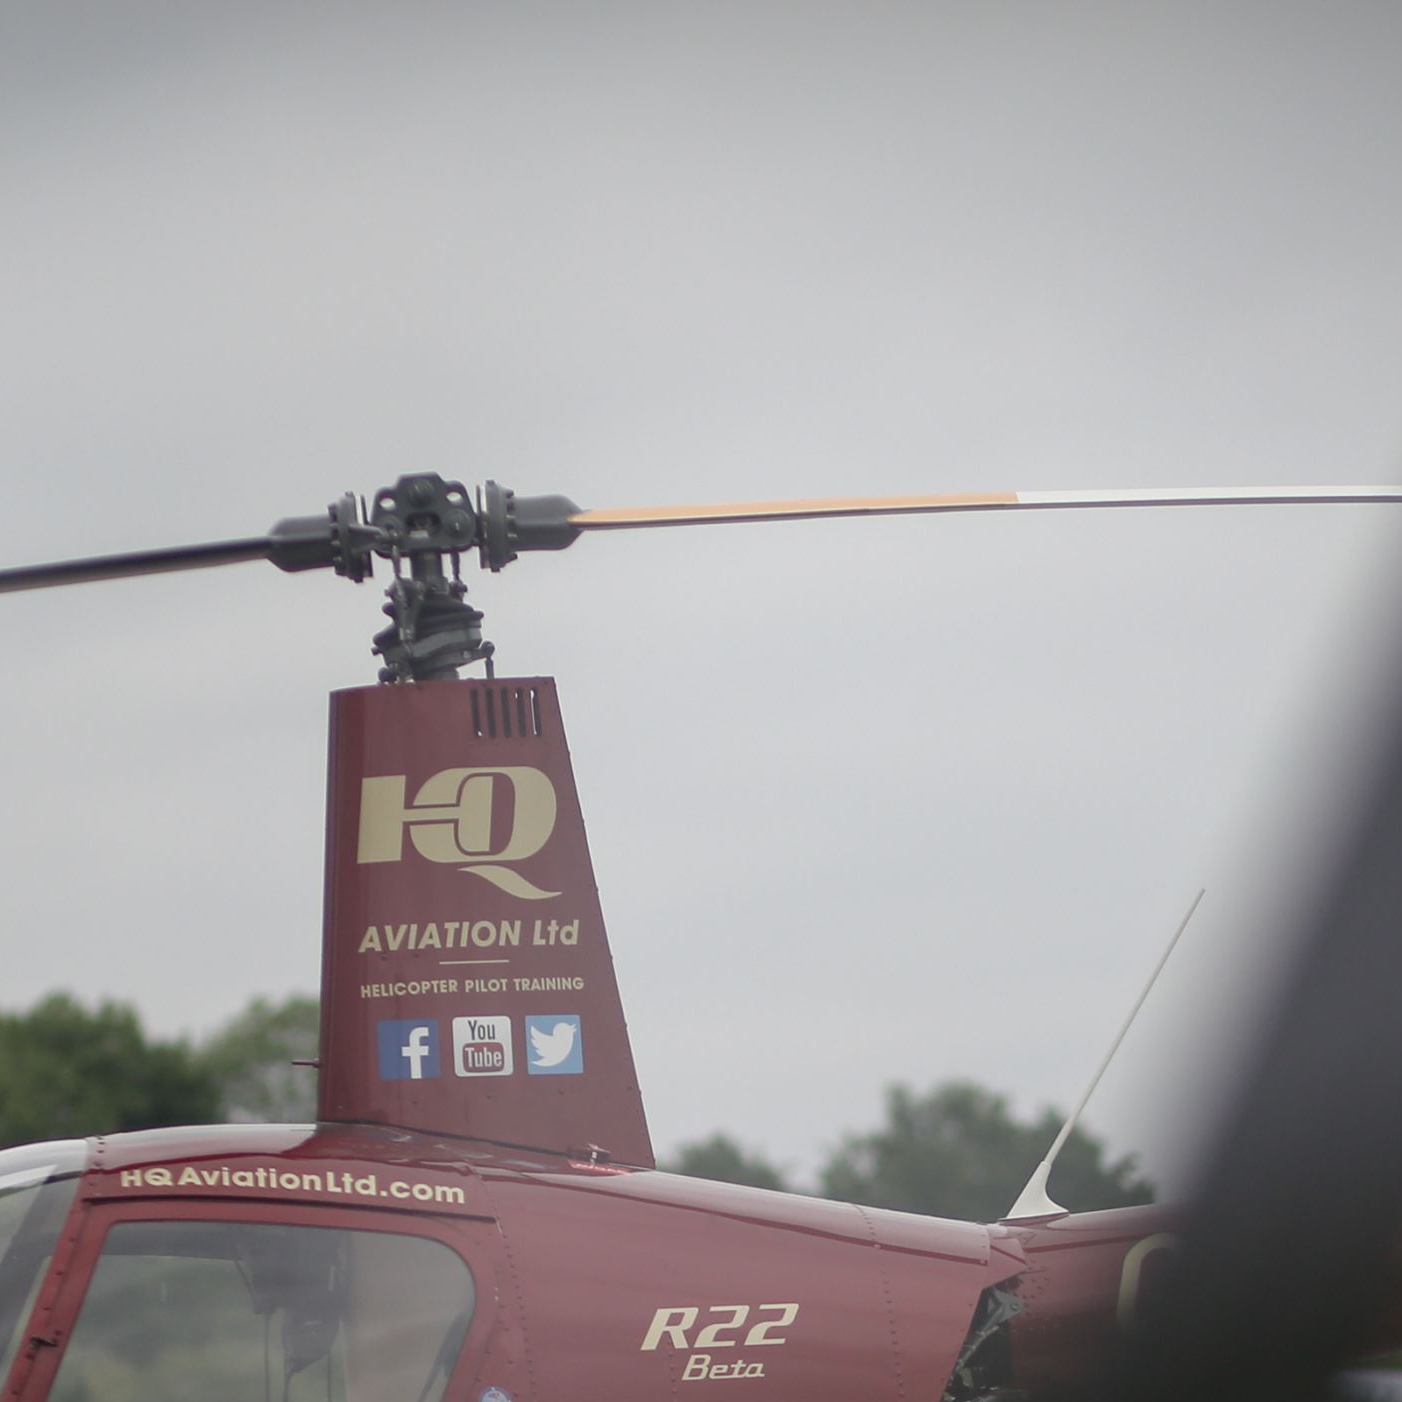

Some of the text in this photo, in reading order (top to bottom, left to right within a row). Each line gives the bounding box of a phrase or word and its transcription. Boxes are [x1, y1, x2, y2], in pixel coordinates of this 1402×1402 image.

[356, 765, 562, 900] HQ
[358, 919, 580, 953] AVIATION Ltd
[360, 976, 585, 999] HELICOPTER PILOT TRAINING
[467, 1019, 496, 1041] You
[464, 1046, 503, 1068] Tube
[640, 1302, 800, 1351] R22
[681, 1353, 766, 1381] Beta
